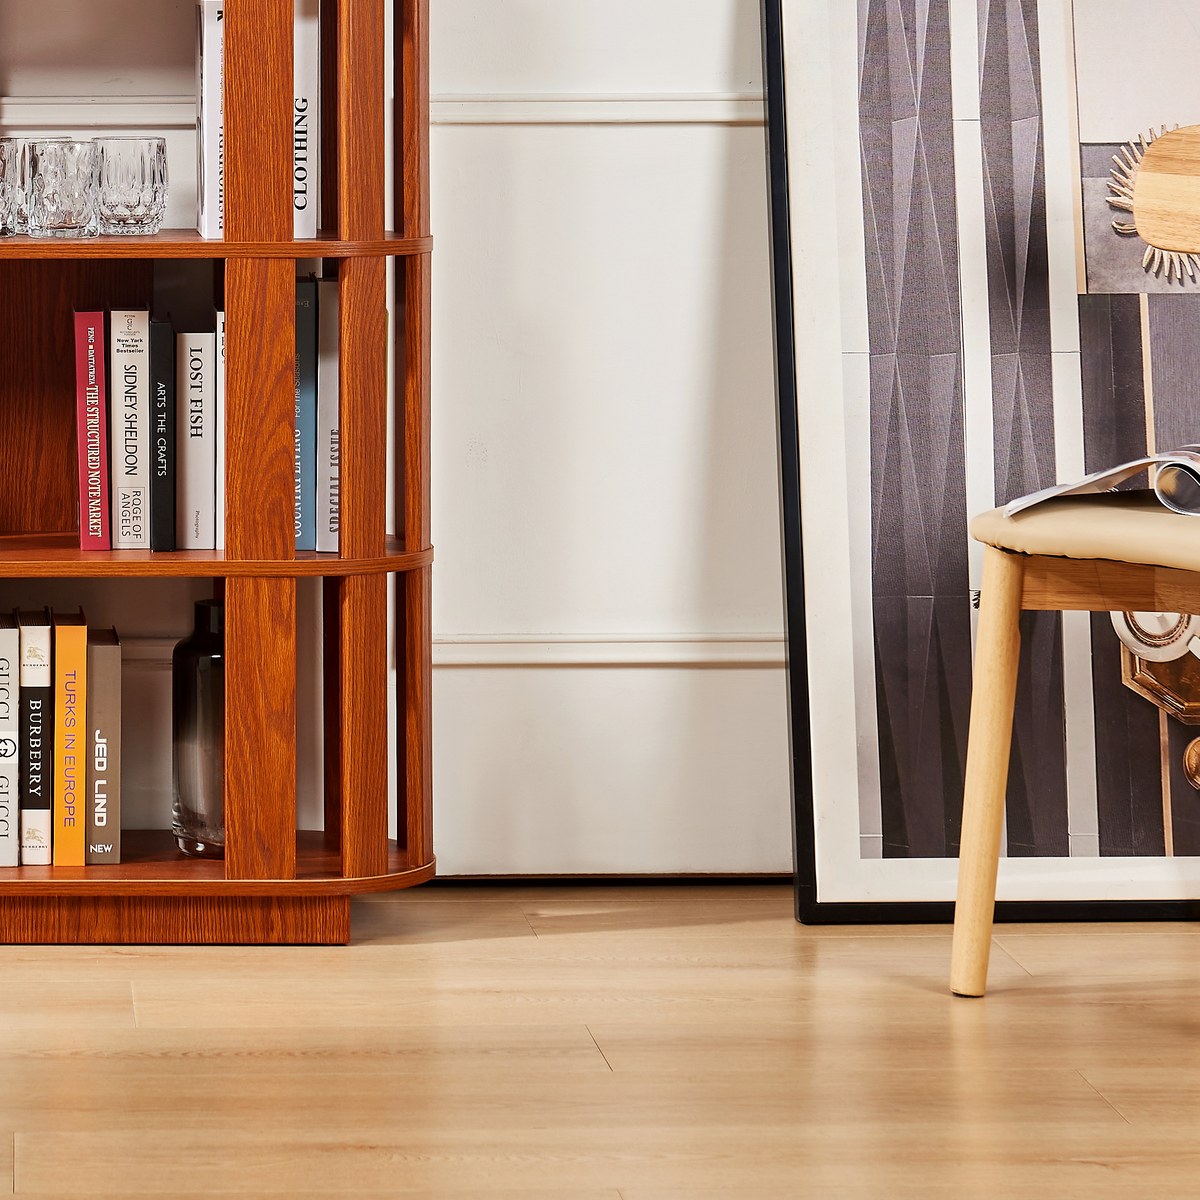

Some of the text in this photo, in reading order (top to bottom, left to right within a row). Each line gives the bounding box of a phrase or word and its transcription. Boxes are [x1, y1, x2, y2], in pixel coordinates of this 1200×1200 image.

[293, 96, 309, 211] CLOTHING
[87, 327, 95, 343] PENG
[86, 385, 98, 406] THE
[123, 364, 138, 476] SIDNEY SHELDON
[156, 381, 167, 477] ARTS THE CRAFTS
[189, 346, 204, 439] LOST FISH
[86, 406, 100, 469] STRUCTURED
[88, 470, 101, 498] NOTE
[121, 492, 131, 537] ANGELS
[132, 524, 142, 539] OF
[28, 699, 42, 797] BURBERRY
[63, 670, 77, 828] TURKS IN EUROPE
[94, 729, 107, 827] JED LIND
[89, 844, 113, 853] NEW
